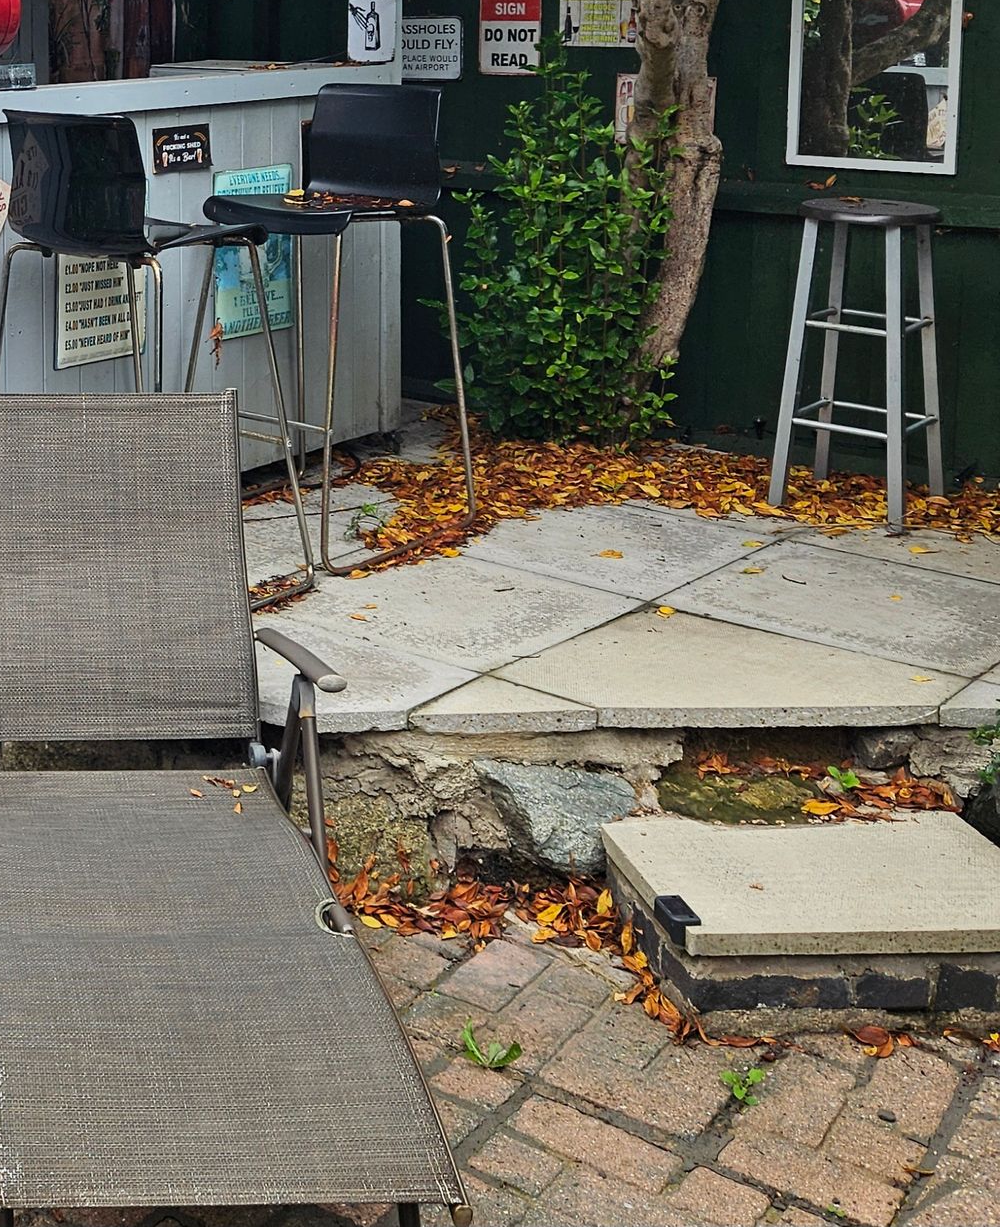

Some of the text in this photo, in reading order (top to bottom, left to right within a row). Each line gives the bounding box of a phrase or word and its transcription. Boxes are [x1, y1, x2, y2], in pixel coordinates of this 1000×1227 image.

[495, 2, 526, 15] SIGN
[484, 28, 537, 42] DO NOT
[402, 39, 430, 50] ULD
[491, 53, 528, 67] READ
[95, 260, 106, 271] NOT
[99, 314, 111, 327] BEEN
[117, 312, 126, 323] ALL
